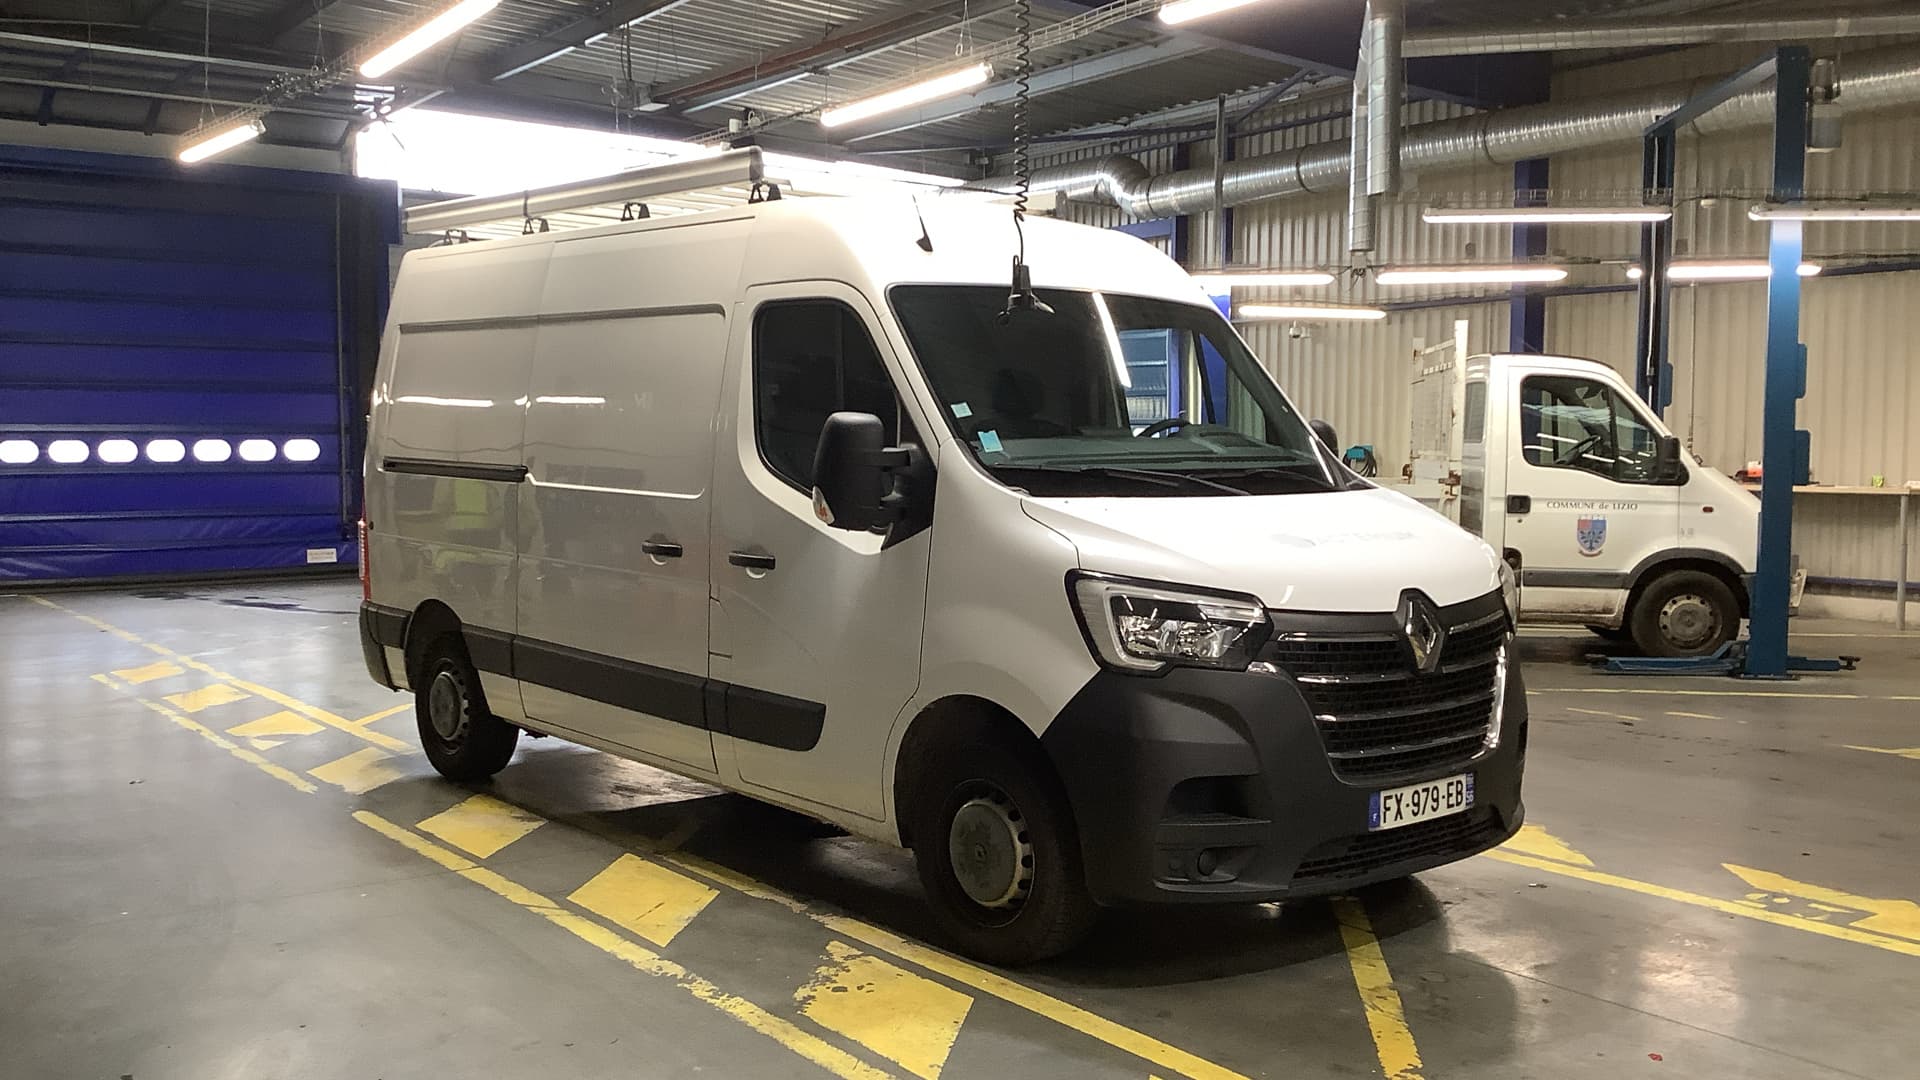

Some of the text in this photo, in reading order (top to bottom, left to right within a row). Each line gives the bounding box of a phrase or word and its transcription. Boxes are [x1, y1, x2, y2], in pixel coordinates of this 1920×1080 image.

[1546, 501, 1639, 511] COMMUNE de LIZIO
[1383, 780, 1464, 823] FX-979-EB
